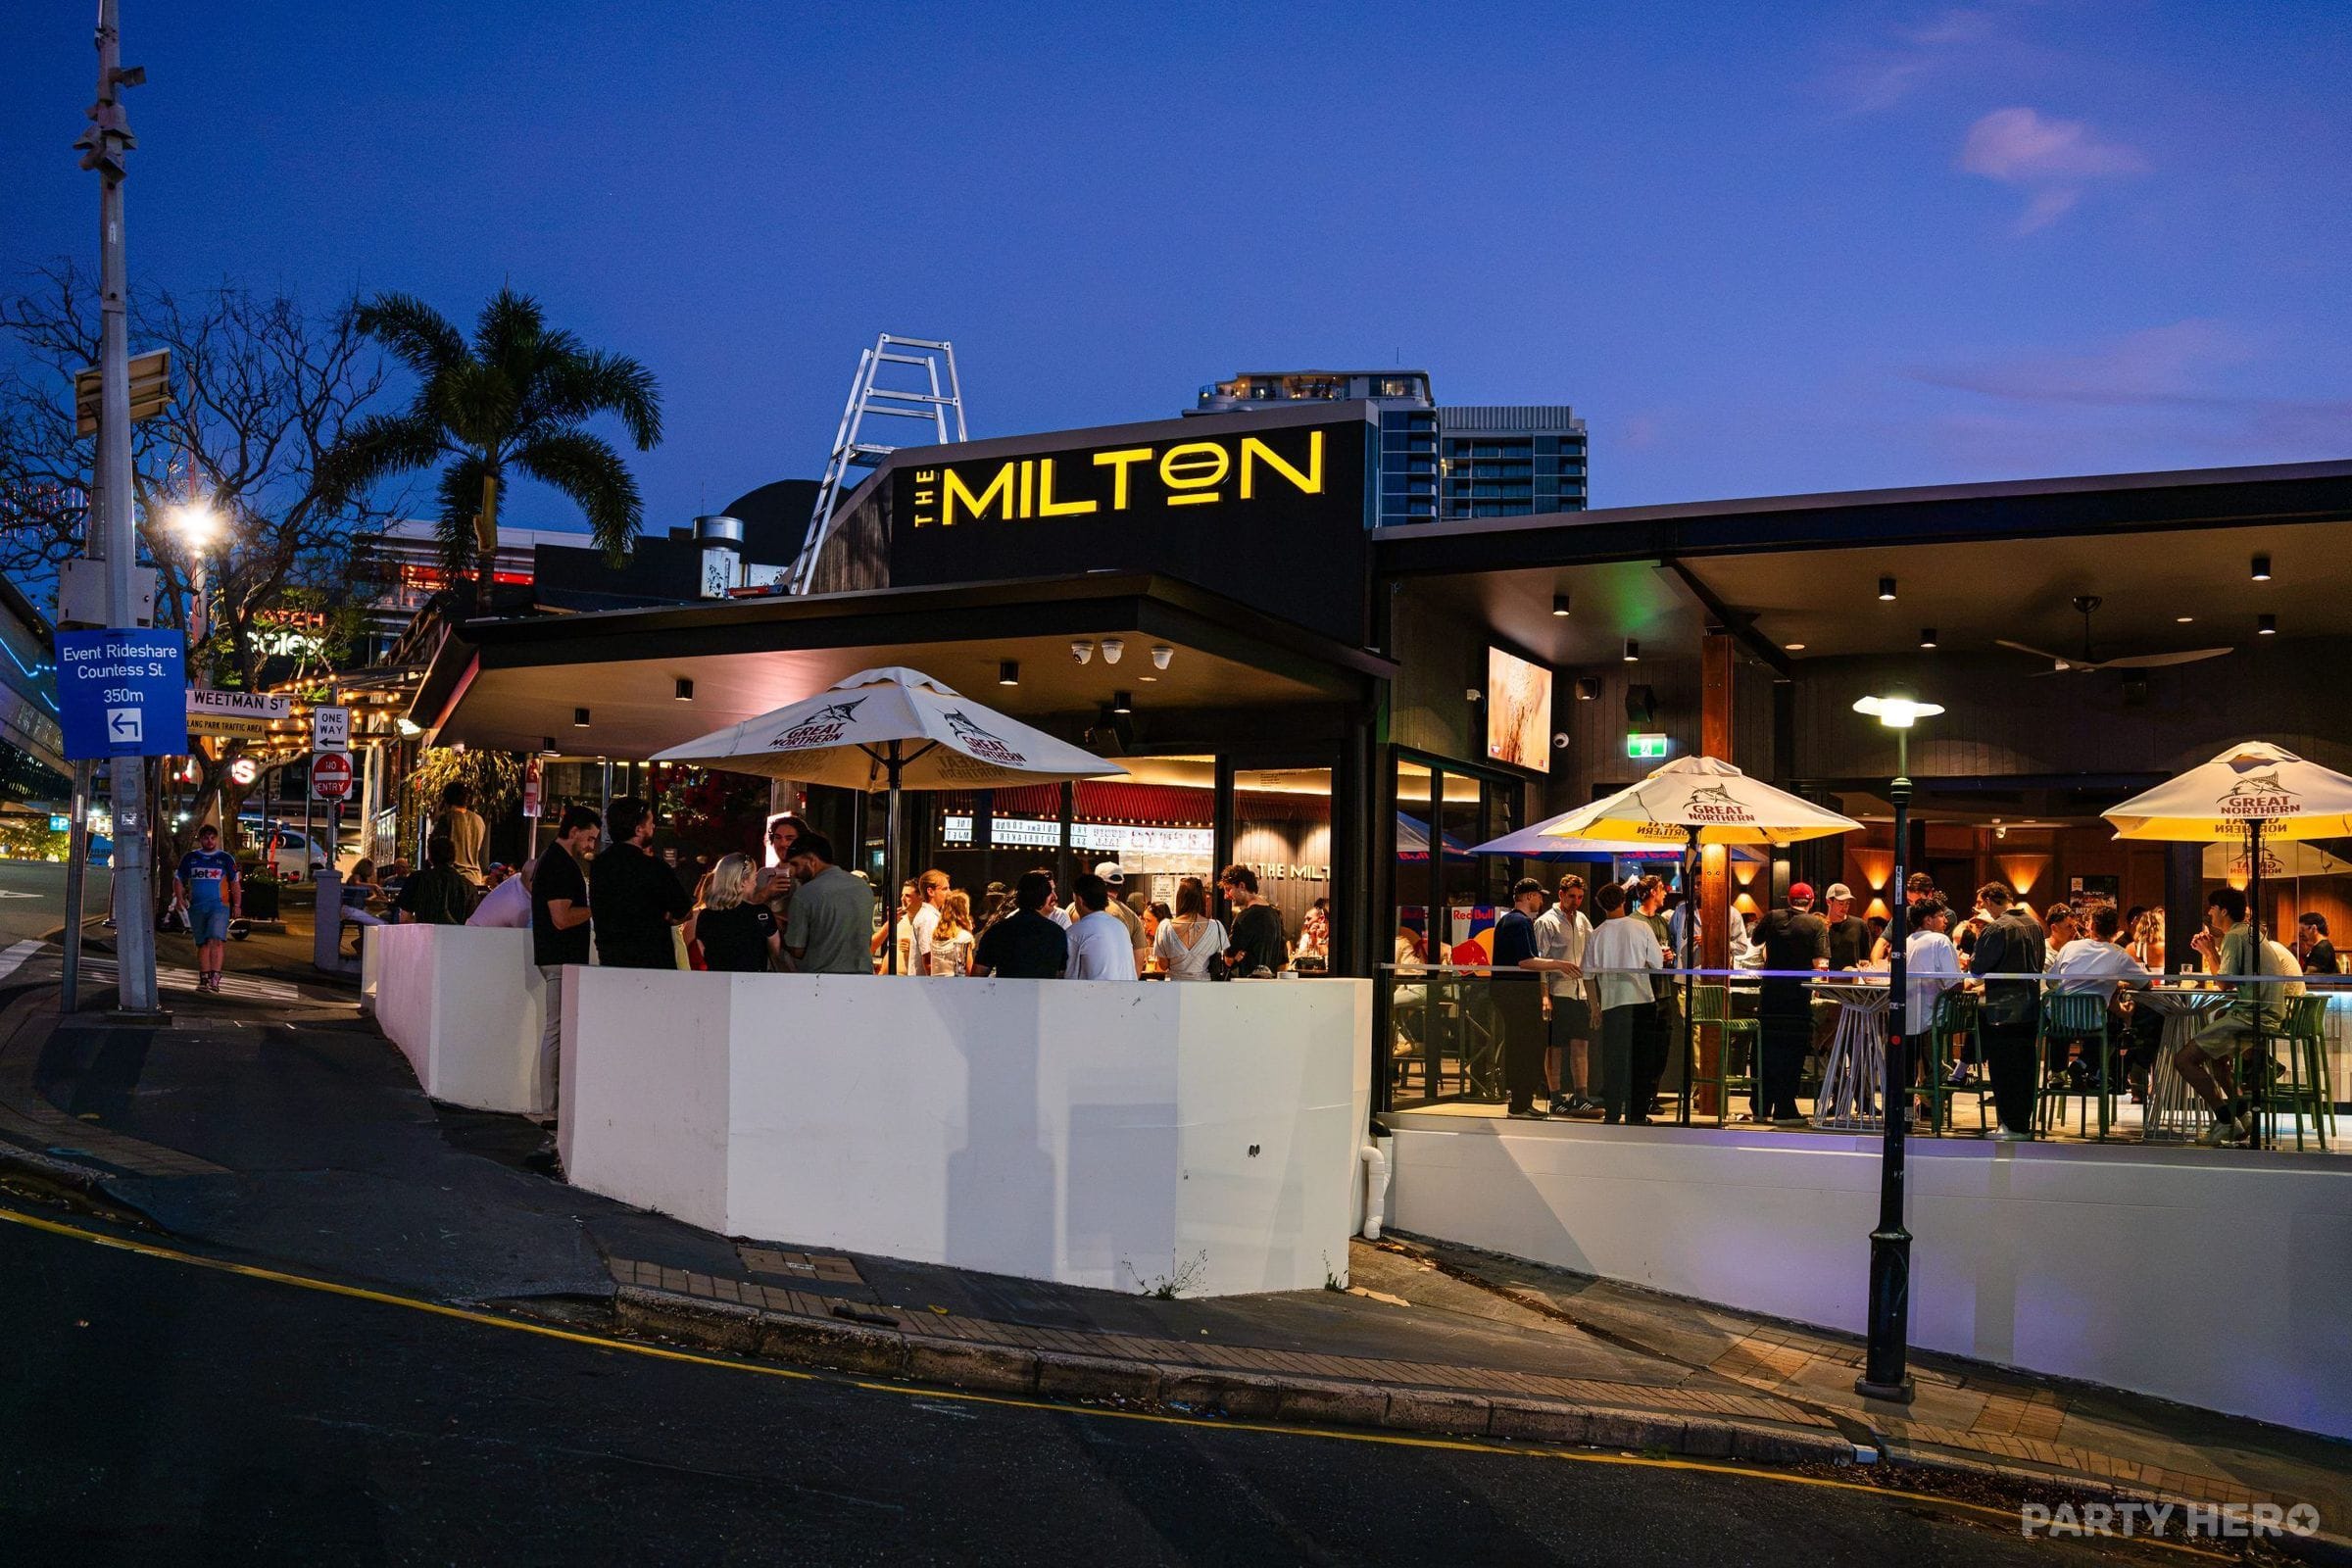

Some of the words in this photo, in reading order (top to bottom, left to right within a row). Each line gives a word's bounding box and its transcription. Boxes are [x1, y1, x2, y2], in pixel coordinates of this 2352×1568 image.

[914, 469, 934, 528] THE
[942, 430, 1327, 526] MILTON
[63, 646, 102, 662] Event
[106, 643, 177, 659] Rideshare
[77, 663, 144, 679] Countess
[148, 662, 167, 676] St.
[103, 688, 144, 703] 350m
[194, 691, 265, 709] WEETMAN
[270, 698, 285, 710] ST
[321, 713, 343, 723] ONE
[221, 722, 246, 732] TRAFFIC
[319, 725, 343, 735] WAY
[787, 722, 847, 739] GREAT
[768, 733, 844, 747] NORTHERN
[961, 736, 1009, 752] GREAT
[325, 760, 337, 770] NO
[318, 782, 345, 792] ENTRY
[2229, 795, 2290, 808] GREAT
[1692, 805, 1743, 814] GREAT
[2221, 804, 2300, 814] NORTHERN
[1257, 862, 1285, 880] THE
[1290, 864, 1330, 881] MILT
[1452, 909, 1472, 920] Red
[1472, 908, 1494, 920] Bull
